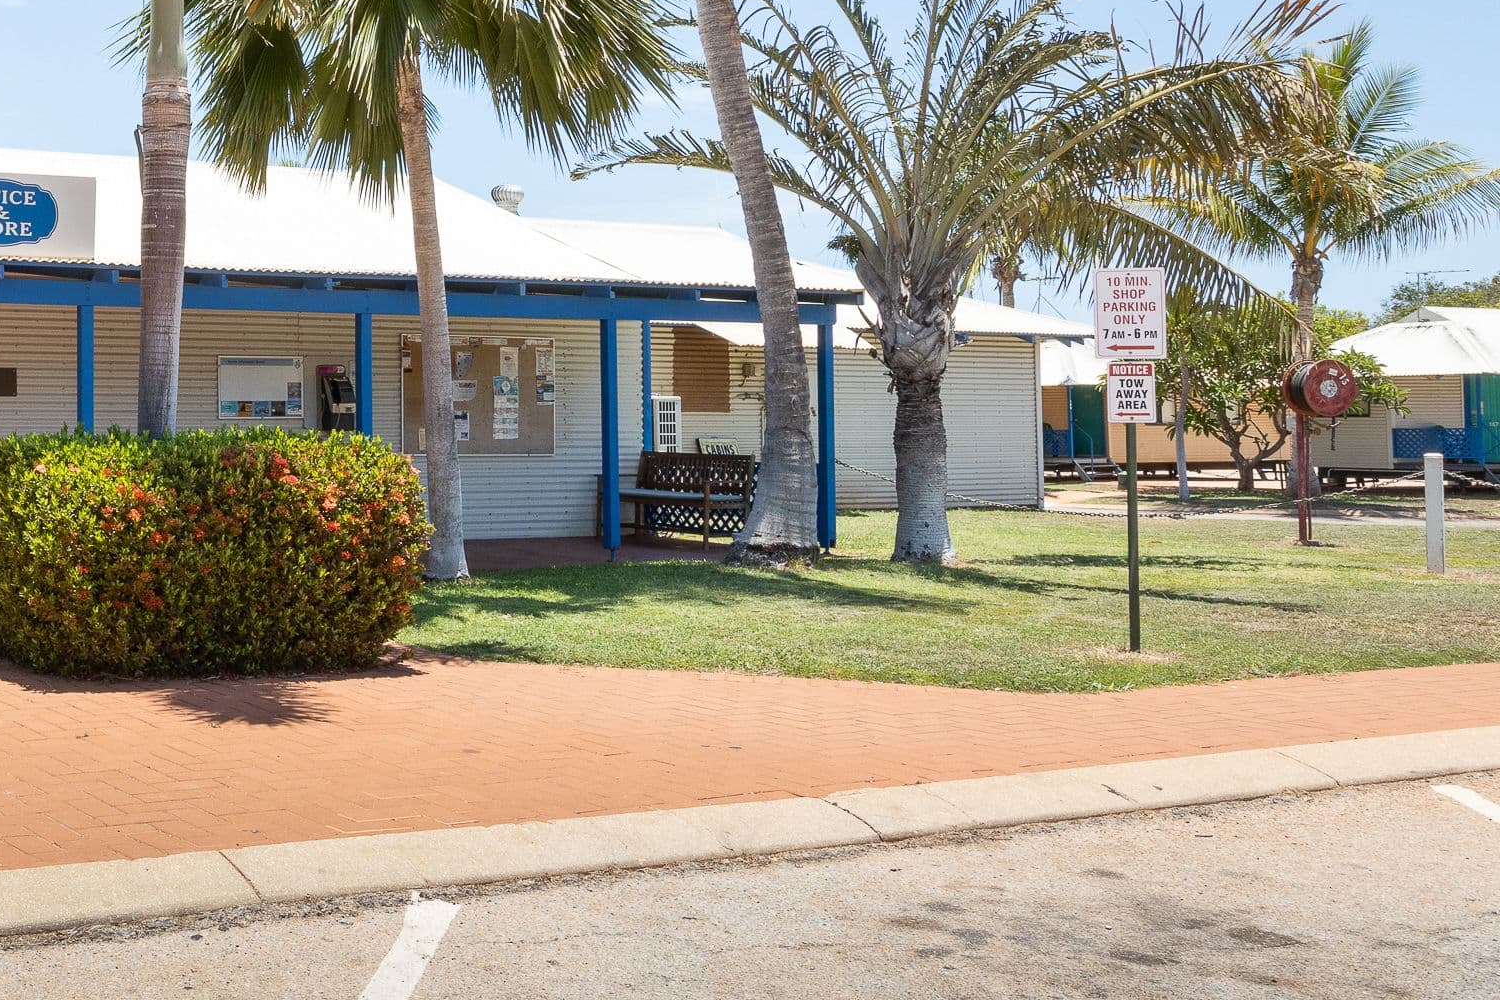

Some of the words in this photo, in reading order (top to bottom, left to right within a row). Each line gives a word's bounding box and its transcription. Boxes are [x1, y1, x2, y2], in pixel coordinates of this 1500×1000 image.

[1107, 277, 1121, 287] 10
[1125, 276, 1152, 286] MIN.
[1112, 289, 1146, 300] SHOP
[1103, 301, 1156, 312] PARKING
[1113, 314, 1146, 325] ONLY
[1103, 328, 1109, 339] 7
[1111, 331, 1125, 339] AM
[1134, 328, 1141, 339] 6
[1144, 331, 1158, 339] PM
[1112, 365, 1149, 375] NOTICE
[1119, 378, 1144, 388] TOW
[1115, 389, 1148, 399] AWAY
[1117, 401, 1147, 410] AREA
